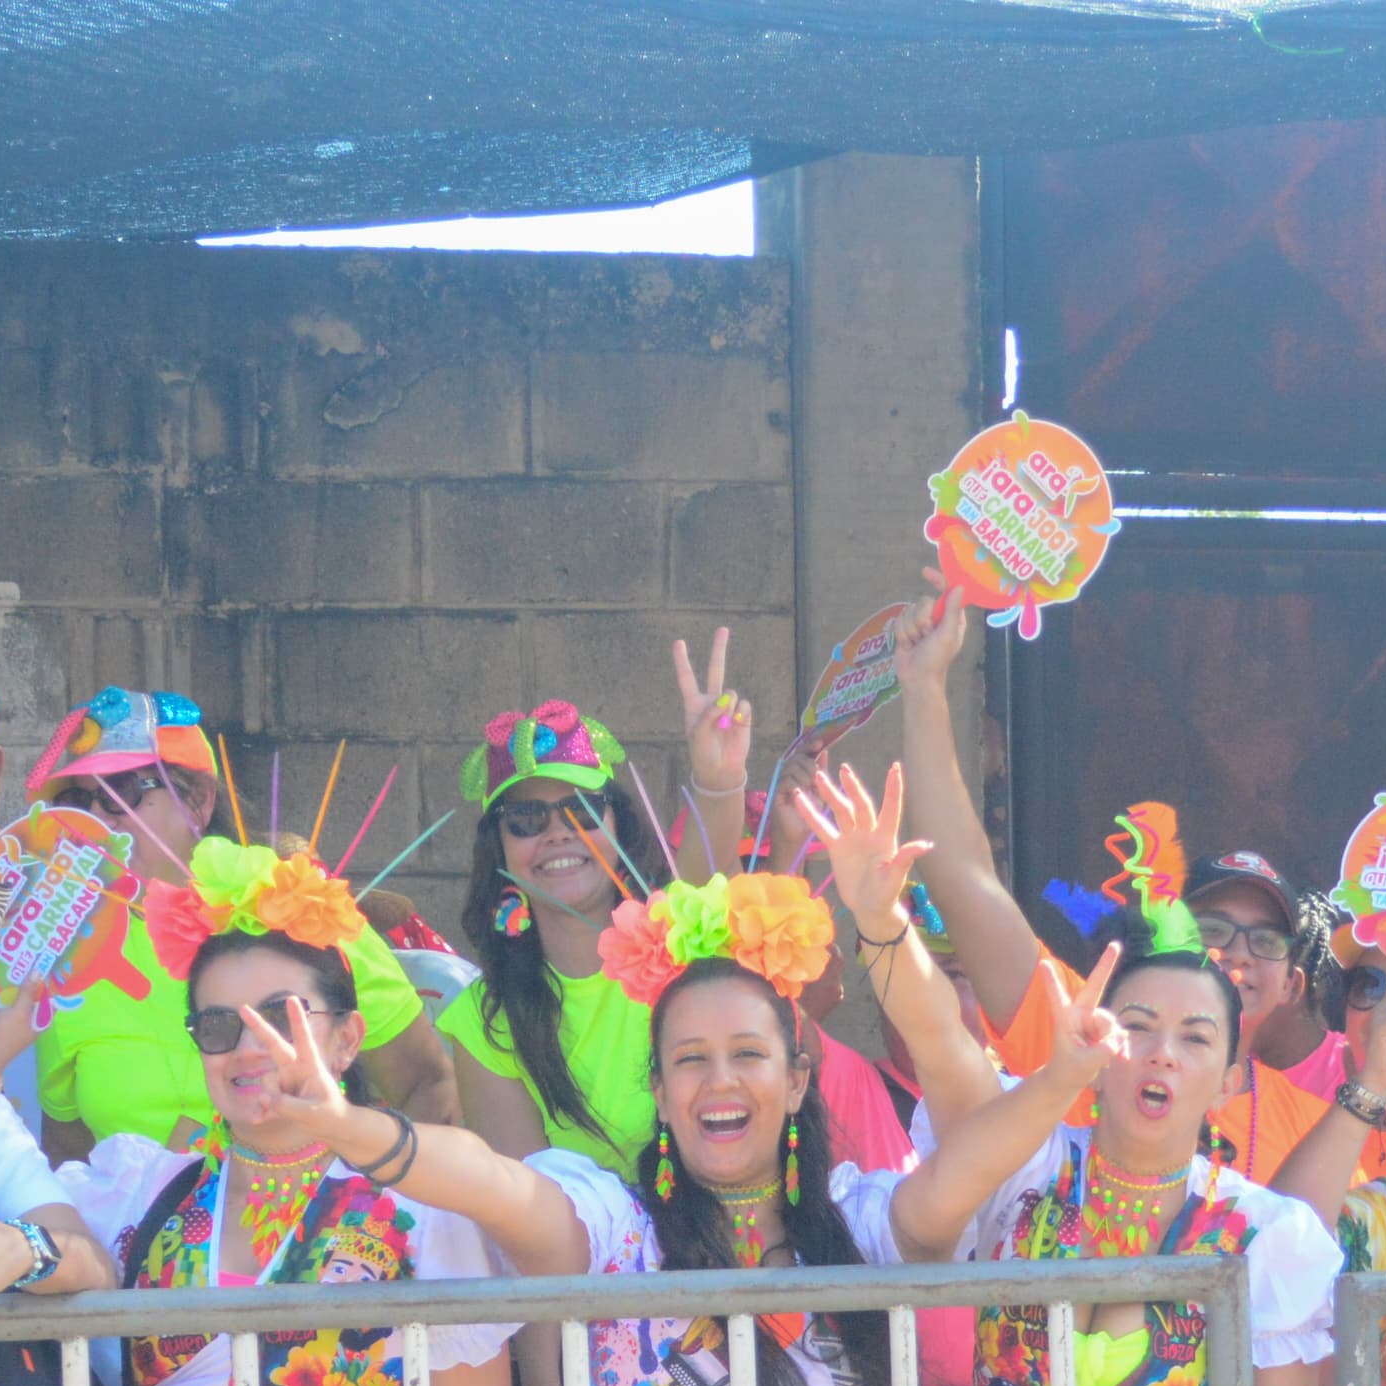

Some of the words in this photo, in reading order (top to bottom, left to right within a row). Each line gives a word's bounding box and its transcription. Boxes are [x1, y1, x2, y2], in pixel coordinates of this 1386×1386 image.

[1029, 453, 1067, 493] ara
[977, 518, 1033, 578] BACANO
[984, 497, 1061, 584] CARNAVAL
[1029, 509, 1076, 556] JOO!
[858, 635, 885, 654] ara
[28, 848, 103, 951] CARNAVAL
[48, 879, 102, 953] BACANO
[1154, 1331, 1196, 1360] Goza
